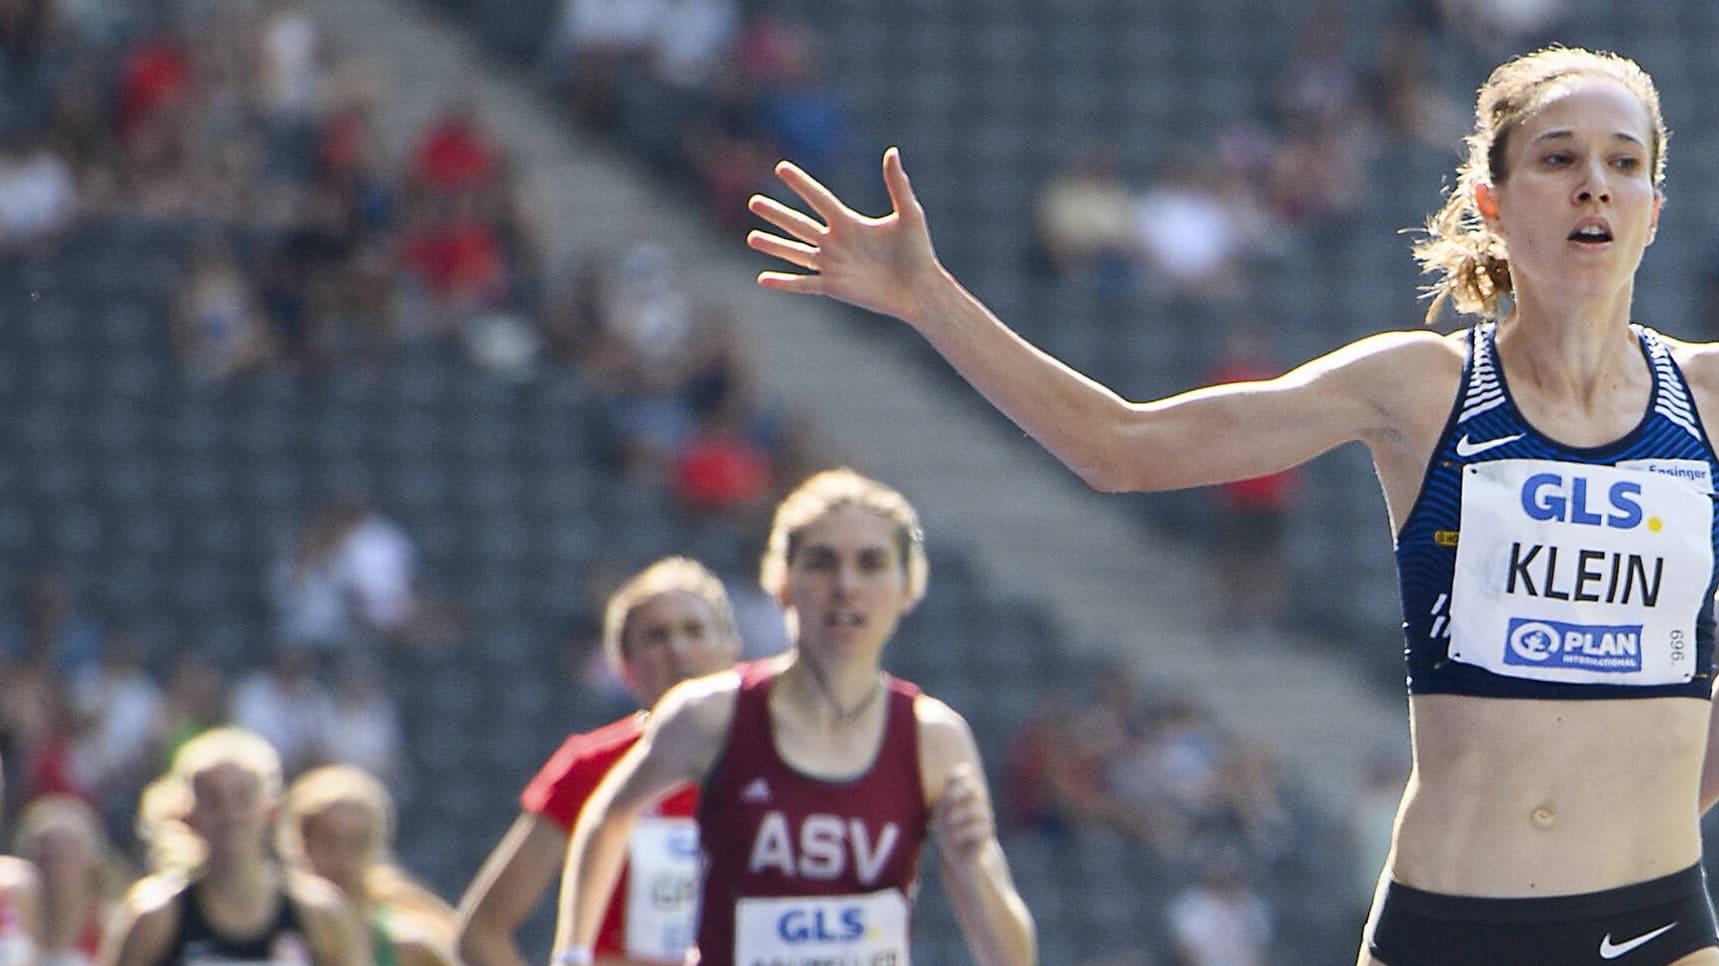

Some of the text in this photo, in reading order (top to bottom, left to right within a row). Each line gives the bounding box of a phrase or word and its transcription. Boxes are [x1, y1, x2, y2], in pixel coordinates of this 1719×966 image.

[1505, 542, 1664, 607] KLEIN
[1562, 655, 1637, 668] INTERNATIONAL
[1564, 631, 1637, 656] PLAN
[749, 810, 898, 885] ASV
